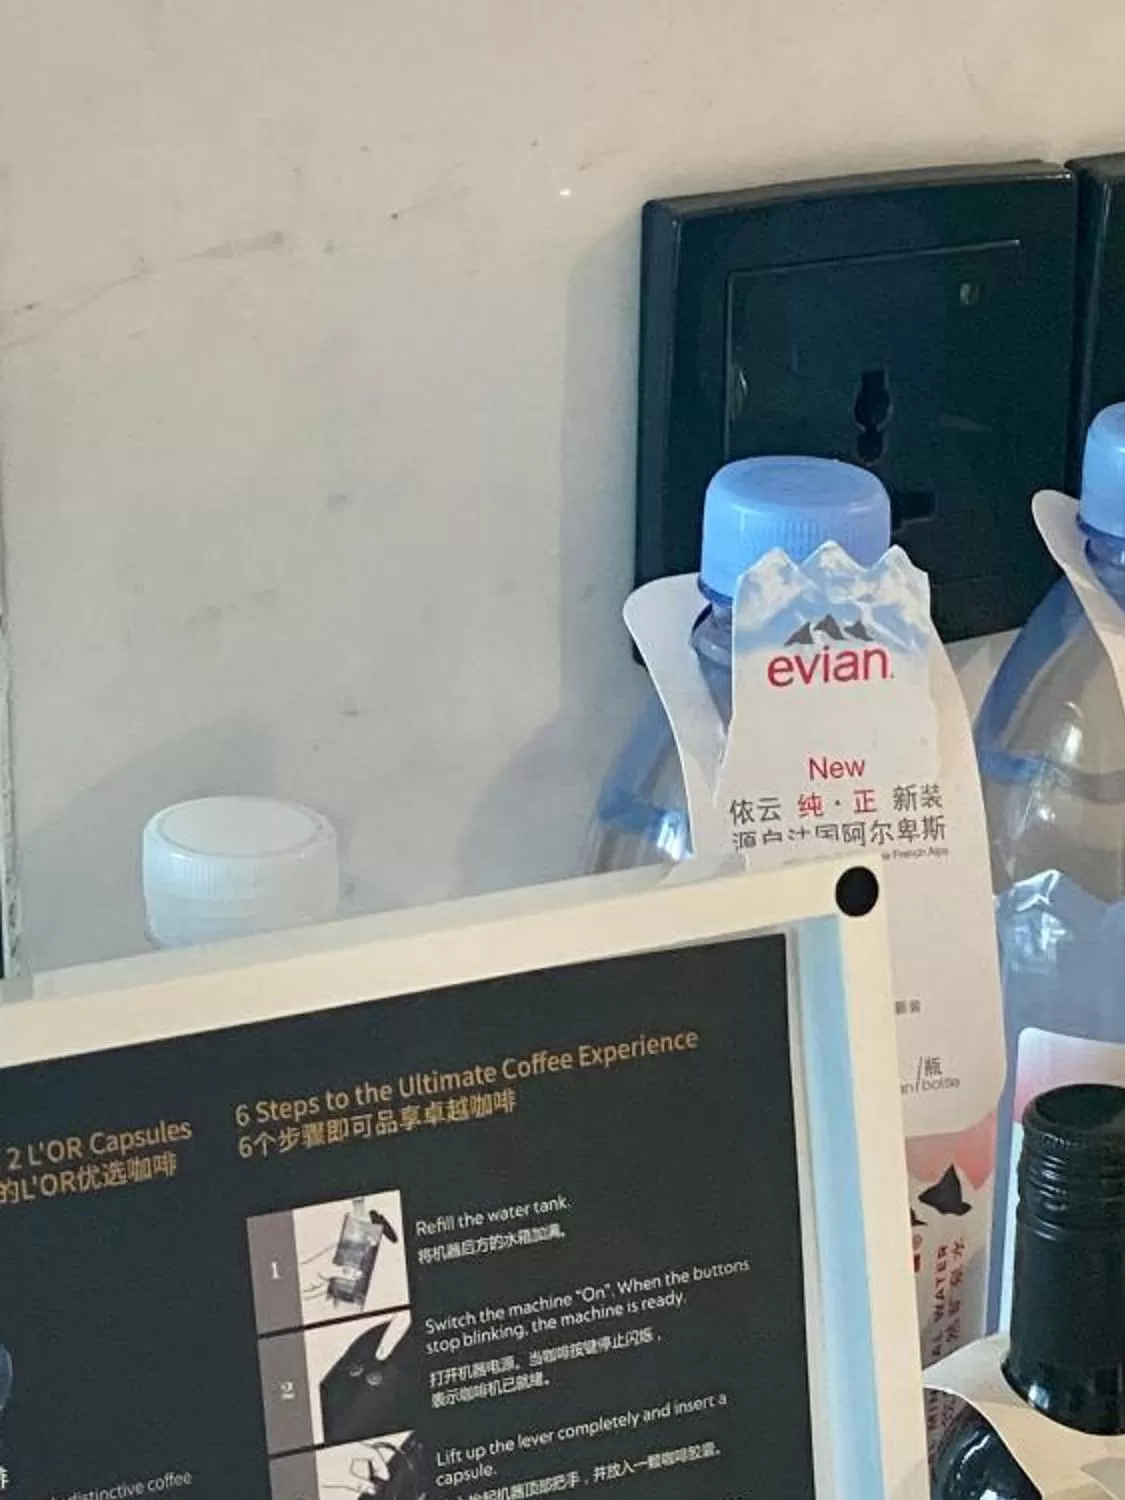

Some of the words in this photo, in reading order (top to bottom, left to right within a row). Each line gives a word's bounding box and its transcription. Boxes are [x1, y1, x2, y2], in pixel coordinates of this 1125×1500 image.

[767, 647, 892, 688] evian
[808, 757, 865, 781] New
[730, 796, 782, 826] 依云
[892, 784, 943, 812] 新装
[236, 1104, 250, 1127] 6
[256, 1095, 320, 1124] Steps
[325, 1089, 348, 1111] to
[356, 1081, 392, 1105] the
[399, 1063, 497, 1098] Ultimate
[502, 1051, 573, 1081] Coffee
[579, 1030, 699, 1069] Experience
[8, 1148, 23, 1170] 2
[29, 1136, 83, 1167] L'OR
[90, 1118, 192, 1160] Capsules
[415, 1211, 455, 1236] Refill
[458, 1210, 483, 1228] the
[487, 1203, 529, 1223] water
[271, 1261, 281, 1279] 1
[425, 1308, 477, 1335] Switch
[479, 1304, 506, 1324] the
[508, 1294, 573, 1319] machine
[616, 1275, 662, 1296] When
[664, 1269, 689, 1287] the
[693, 1259, 750, 1282] buttons
[425, 1336, 461, 1356] stop
[531, 1314, 557, 1334] the
[560, 1304, 624, 1328] machine
[627, 1299, 639, 1314] is
[641, 1290, 687, 1311] ready.
[436, 1449, 463, 1468] Lift
[465, 1445, 486, 1463] up
[489, 1438, 515, 1456] the
[517, 1429, 556, 1450] lever
[557, 1411, 640, 1442] completely
[643, 1403, 671, 1422] and
[674, 1395, 716, 1415] insert
[718, 1393, 727, 1406] a
[147, 1472, 192, 1493] coffee
[435, 1463, 497, 1490] capsule.
